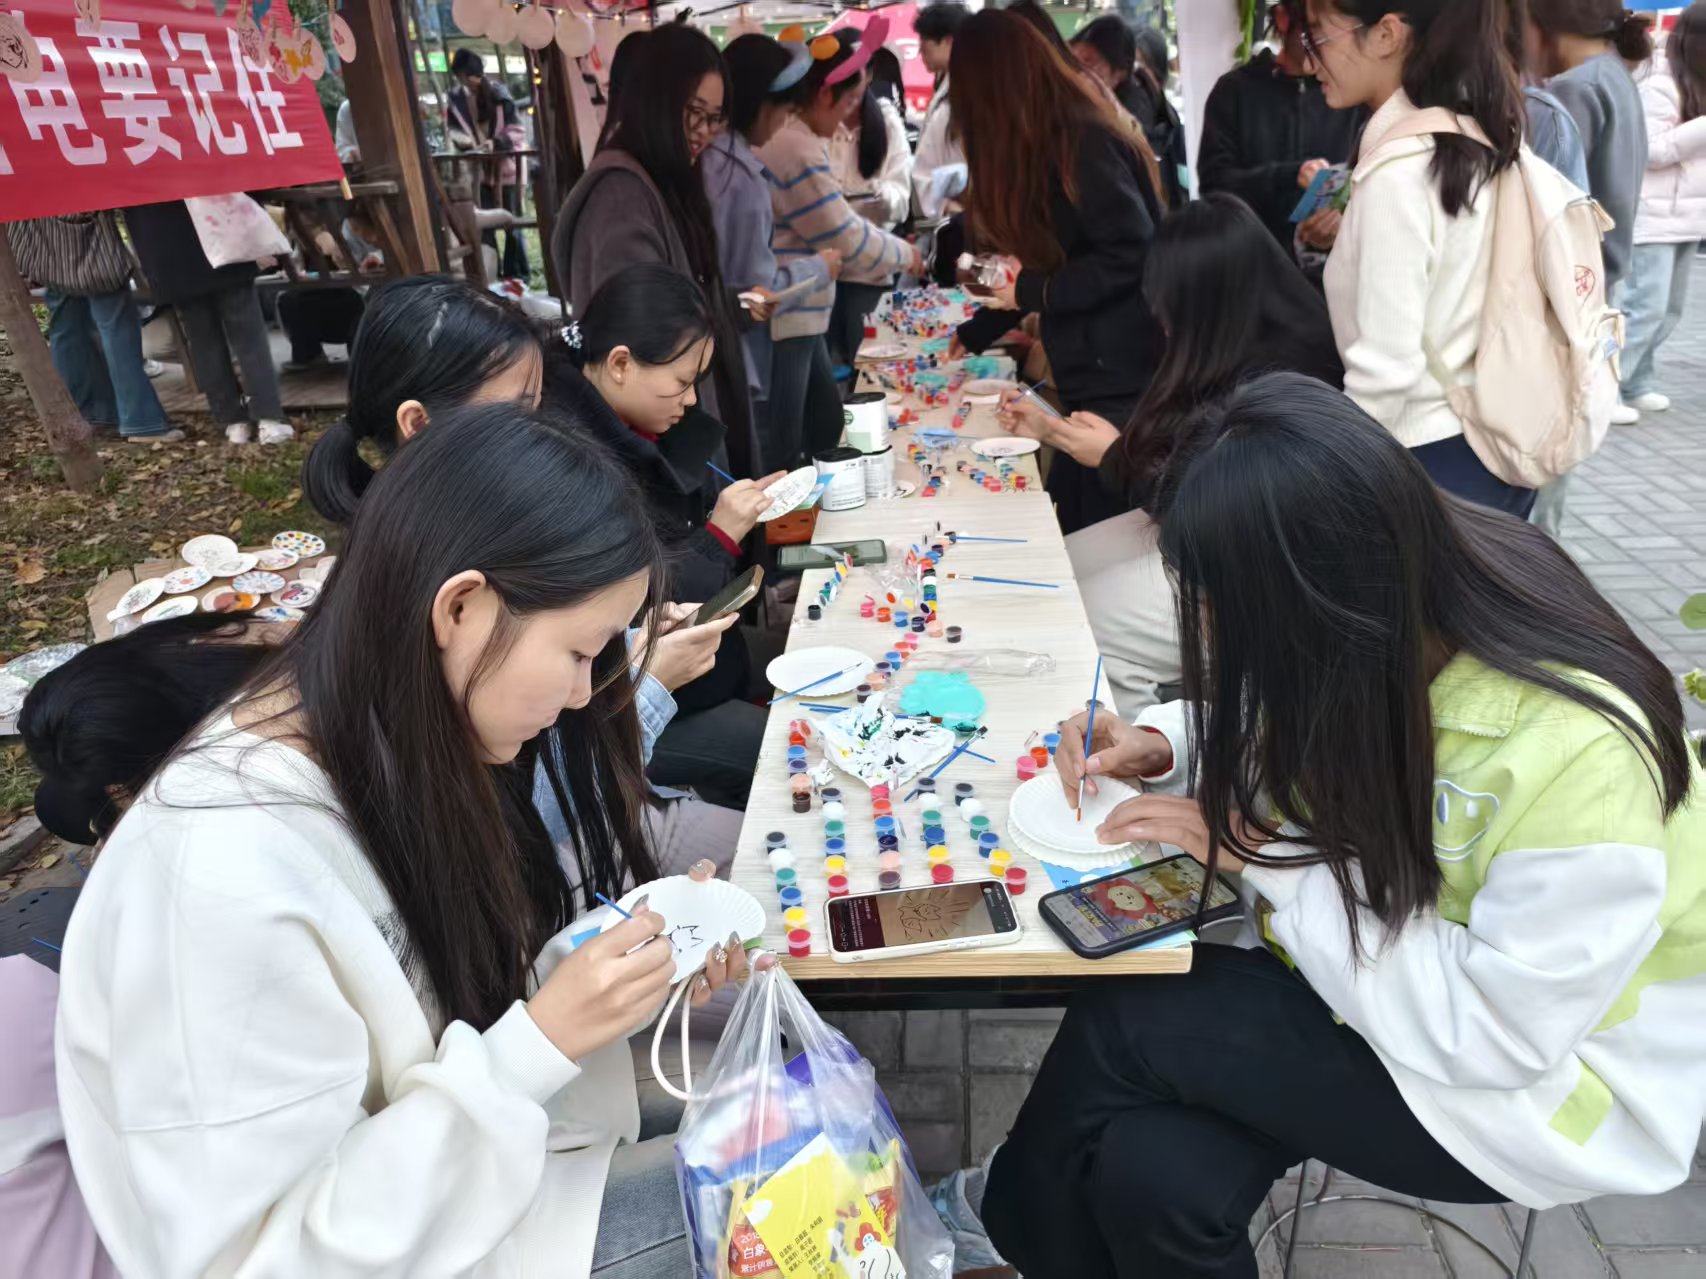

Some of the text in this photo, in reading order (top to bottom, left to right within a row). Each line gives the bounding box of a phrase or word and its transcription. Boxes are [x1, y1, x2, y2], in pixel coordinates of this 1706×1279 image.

[0, 10, 304, 175] 电要记住
[743, 1243, 768, 1260] 白象
